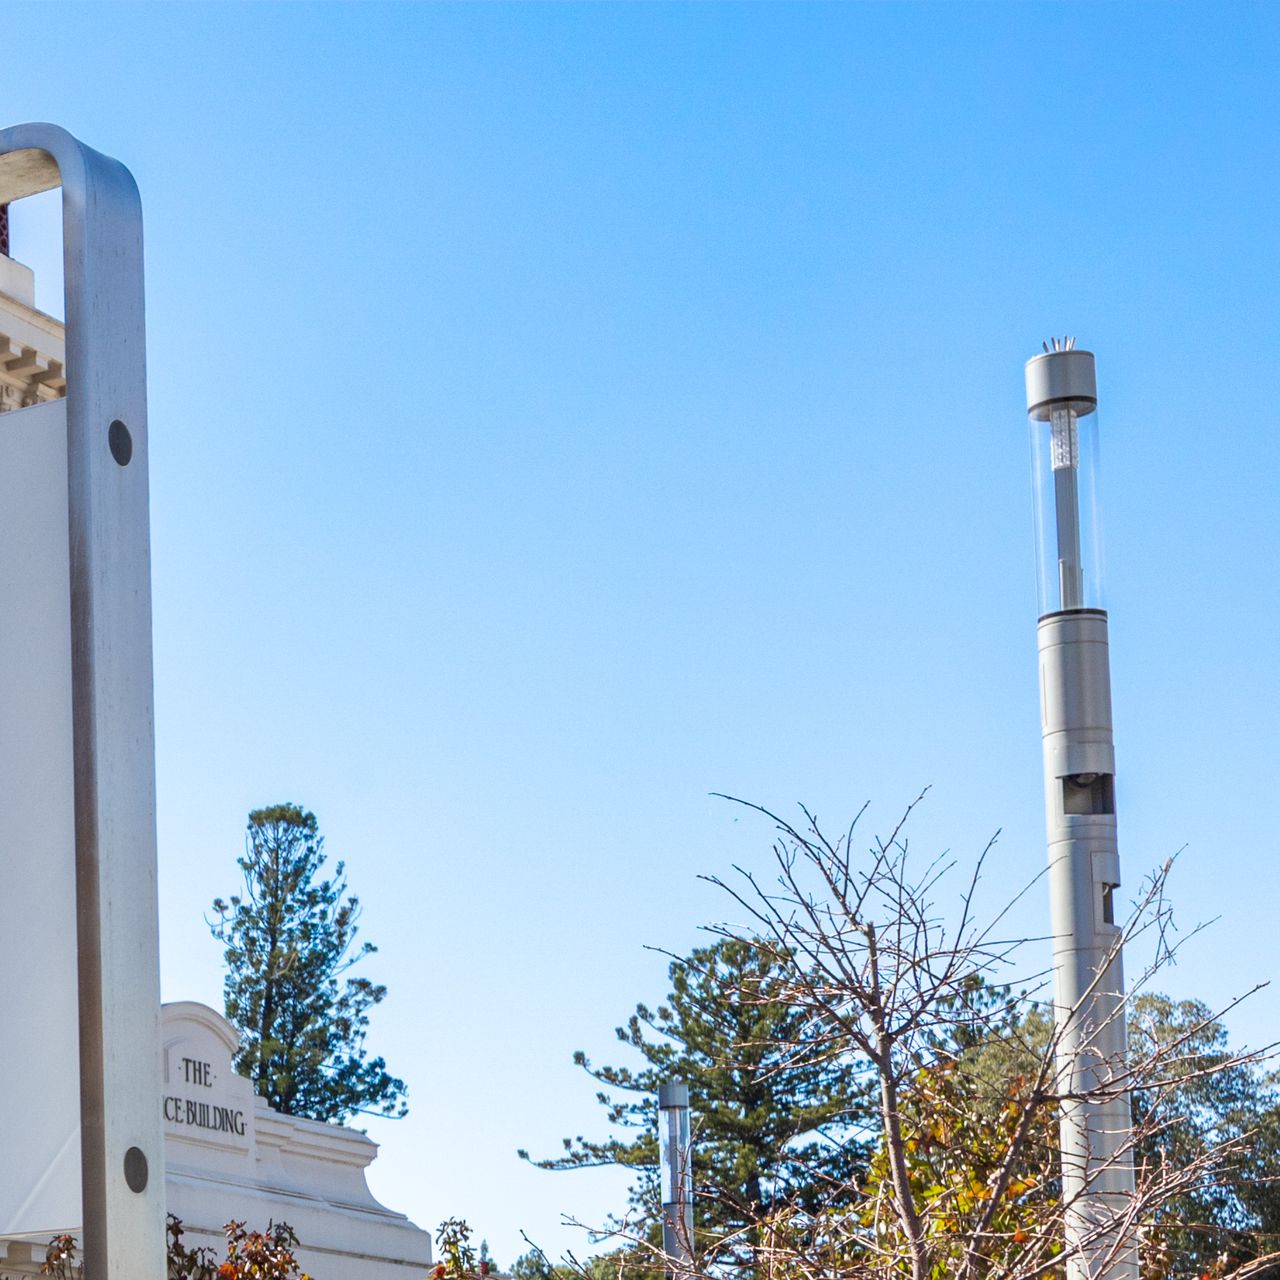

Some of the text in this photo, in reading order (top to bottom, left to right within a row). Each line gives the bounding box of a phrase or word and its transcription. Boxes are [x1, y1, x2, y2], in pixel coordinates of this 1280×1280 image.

[182, 1057, 212, 1088] THE
[163, 1096, 245, 1136] CE BUILDING
